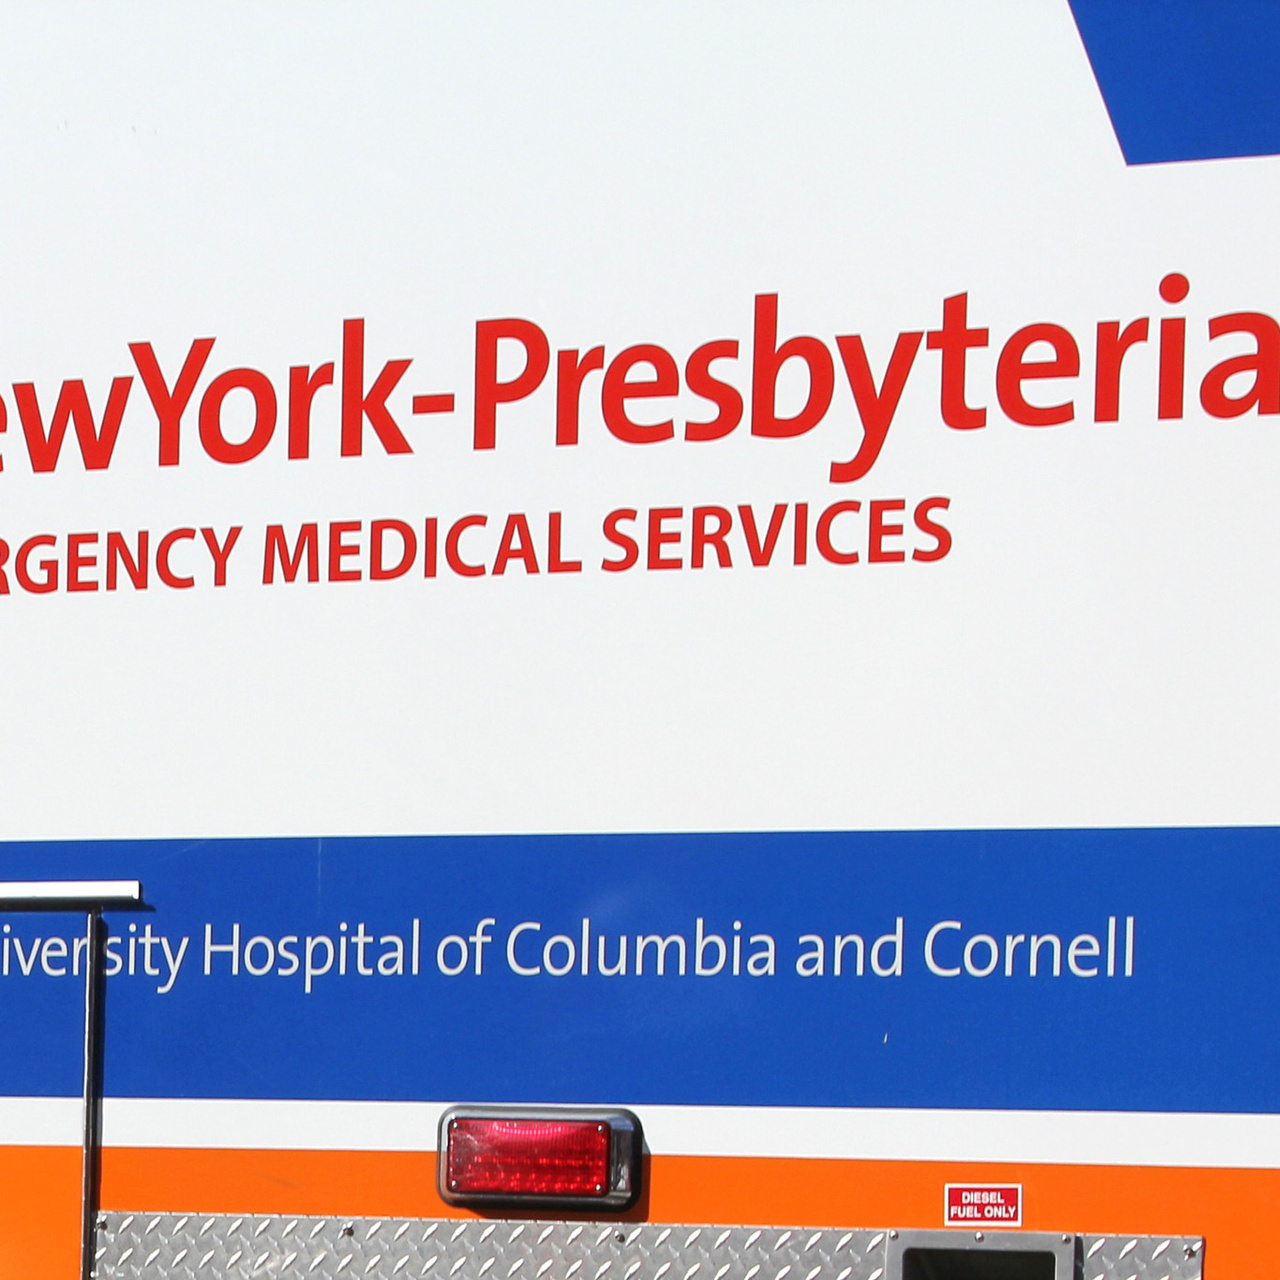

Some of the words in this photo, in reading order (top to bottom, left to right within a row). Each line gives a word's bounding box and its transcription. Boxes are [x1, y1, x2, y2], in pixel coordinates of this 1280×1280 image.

[263, 512, 583, 584] MEDICAL
[602, 497, 953, 572] SERVICES
[205, 919, 420, 994] Hospital
[437, 918, 495, 976] of
[507, 918, 775, 976] Columbia
[796, 917, 904, 977] and
[925, 917, 1134, 977] Cornell
[950, 1206, 982, 1218] FUEL
[984, 1206, 1016, 1218] ONLY
[962, 1191, 1005, 1204] DIESEL
